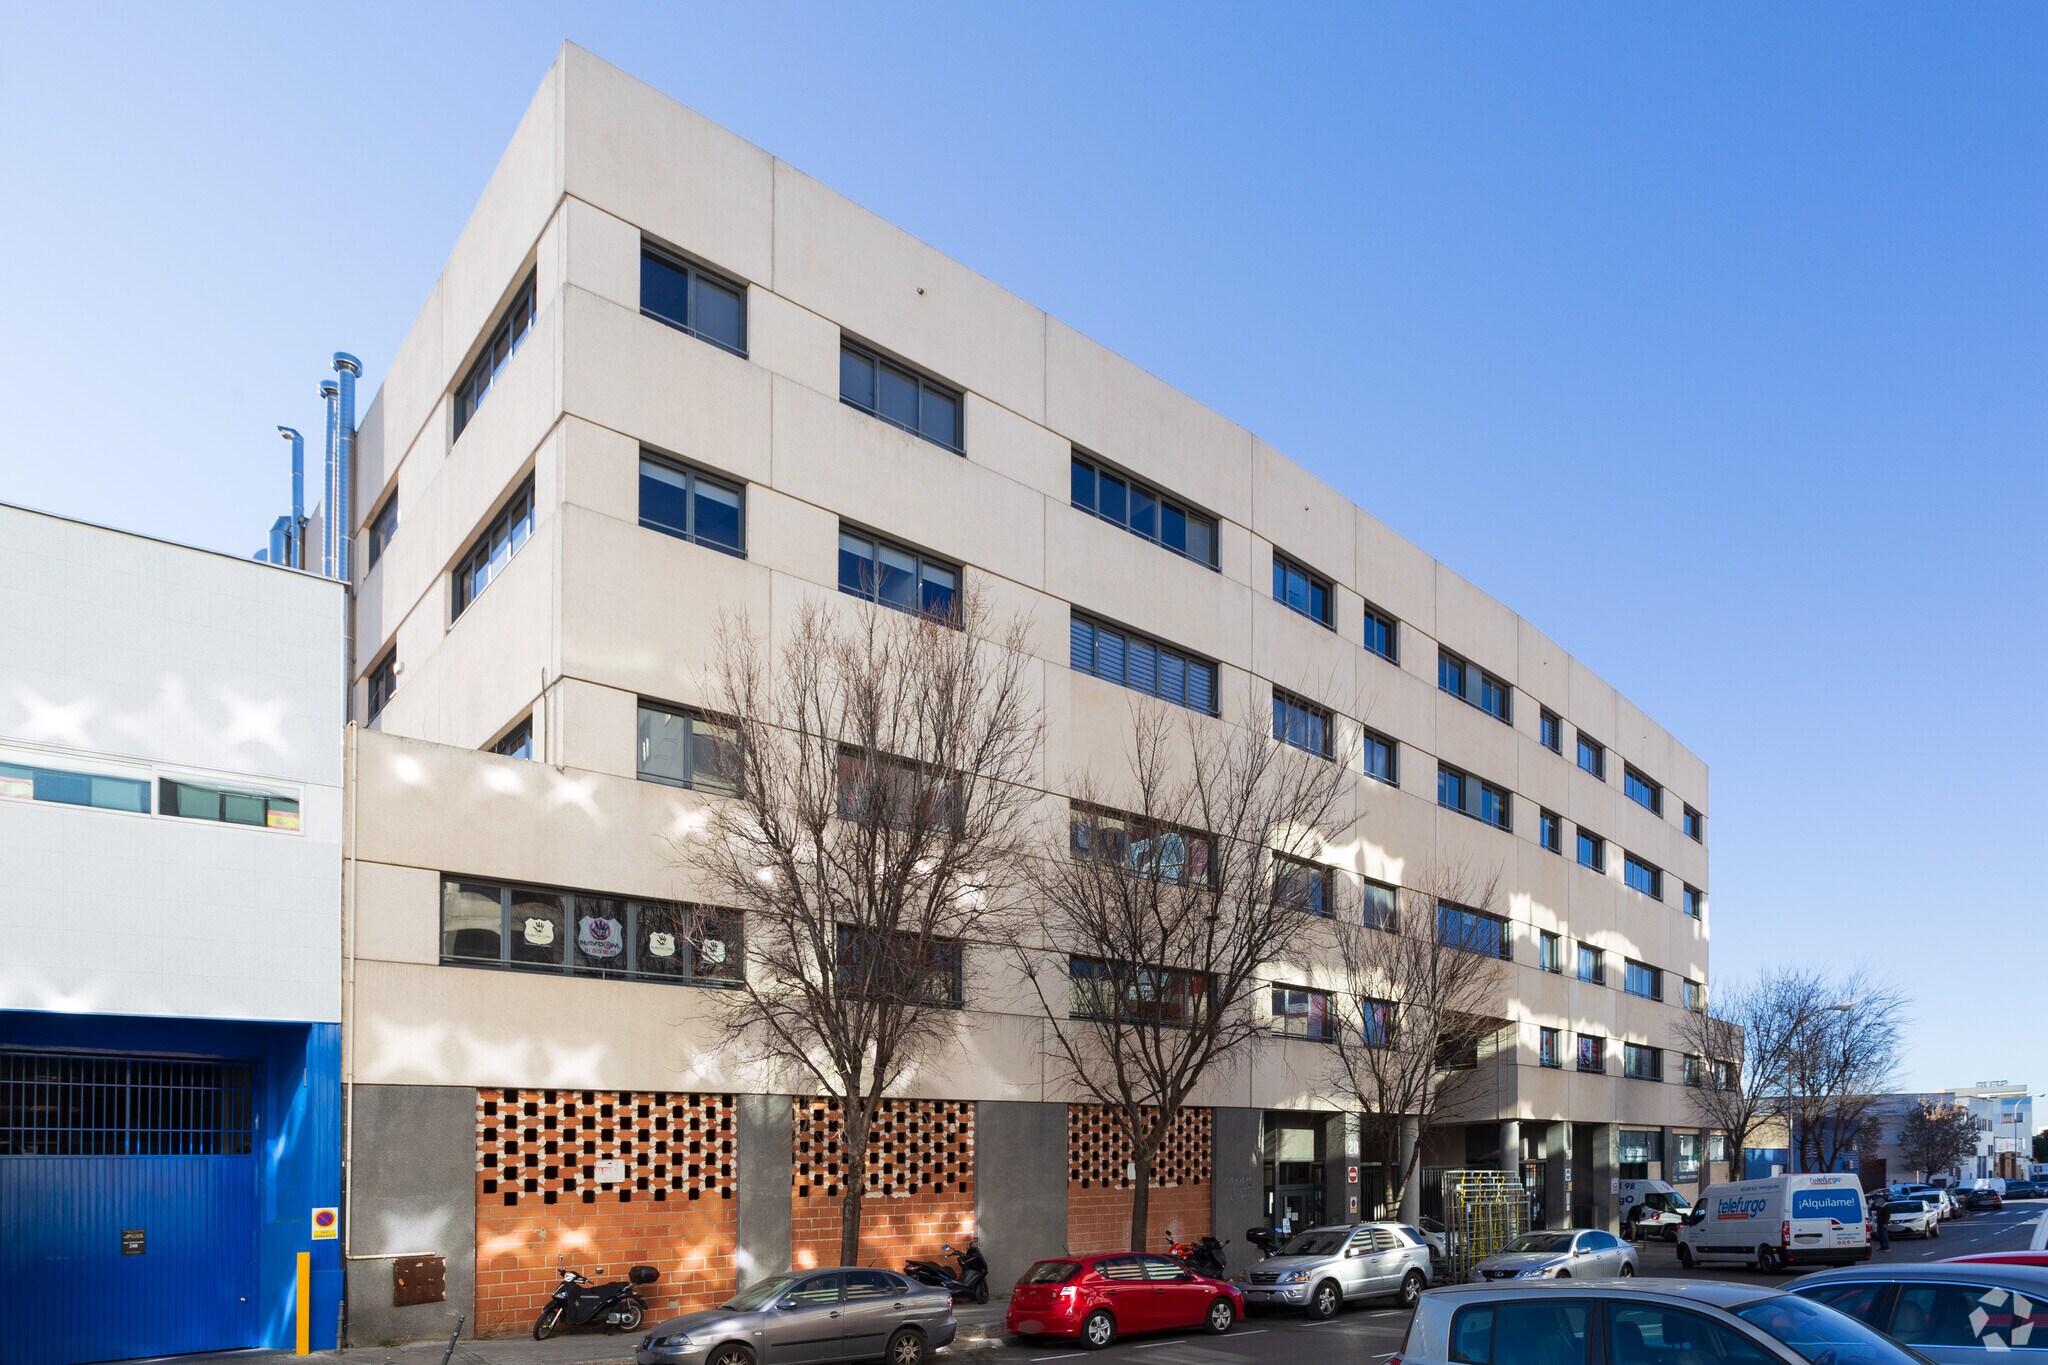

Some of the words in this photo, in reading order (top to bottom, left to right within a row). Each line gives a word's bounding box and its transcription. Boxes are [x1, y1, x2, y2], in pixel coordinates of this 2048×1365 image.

[1348, 1140, 1359, 1155] 20
[1624, 1182, 1635, 1190] 98
[1809, 1176, 1842, 1185] telefurgo
[1718, 1196, 1767, 1217] telefurgo
[1798, 1197, 1855, 1210] ¡Alquílame!
